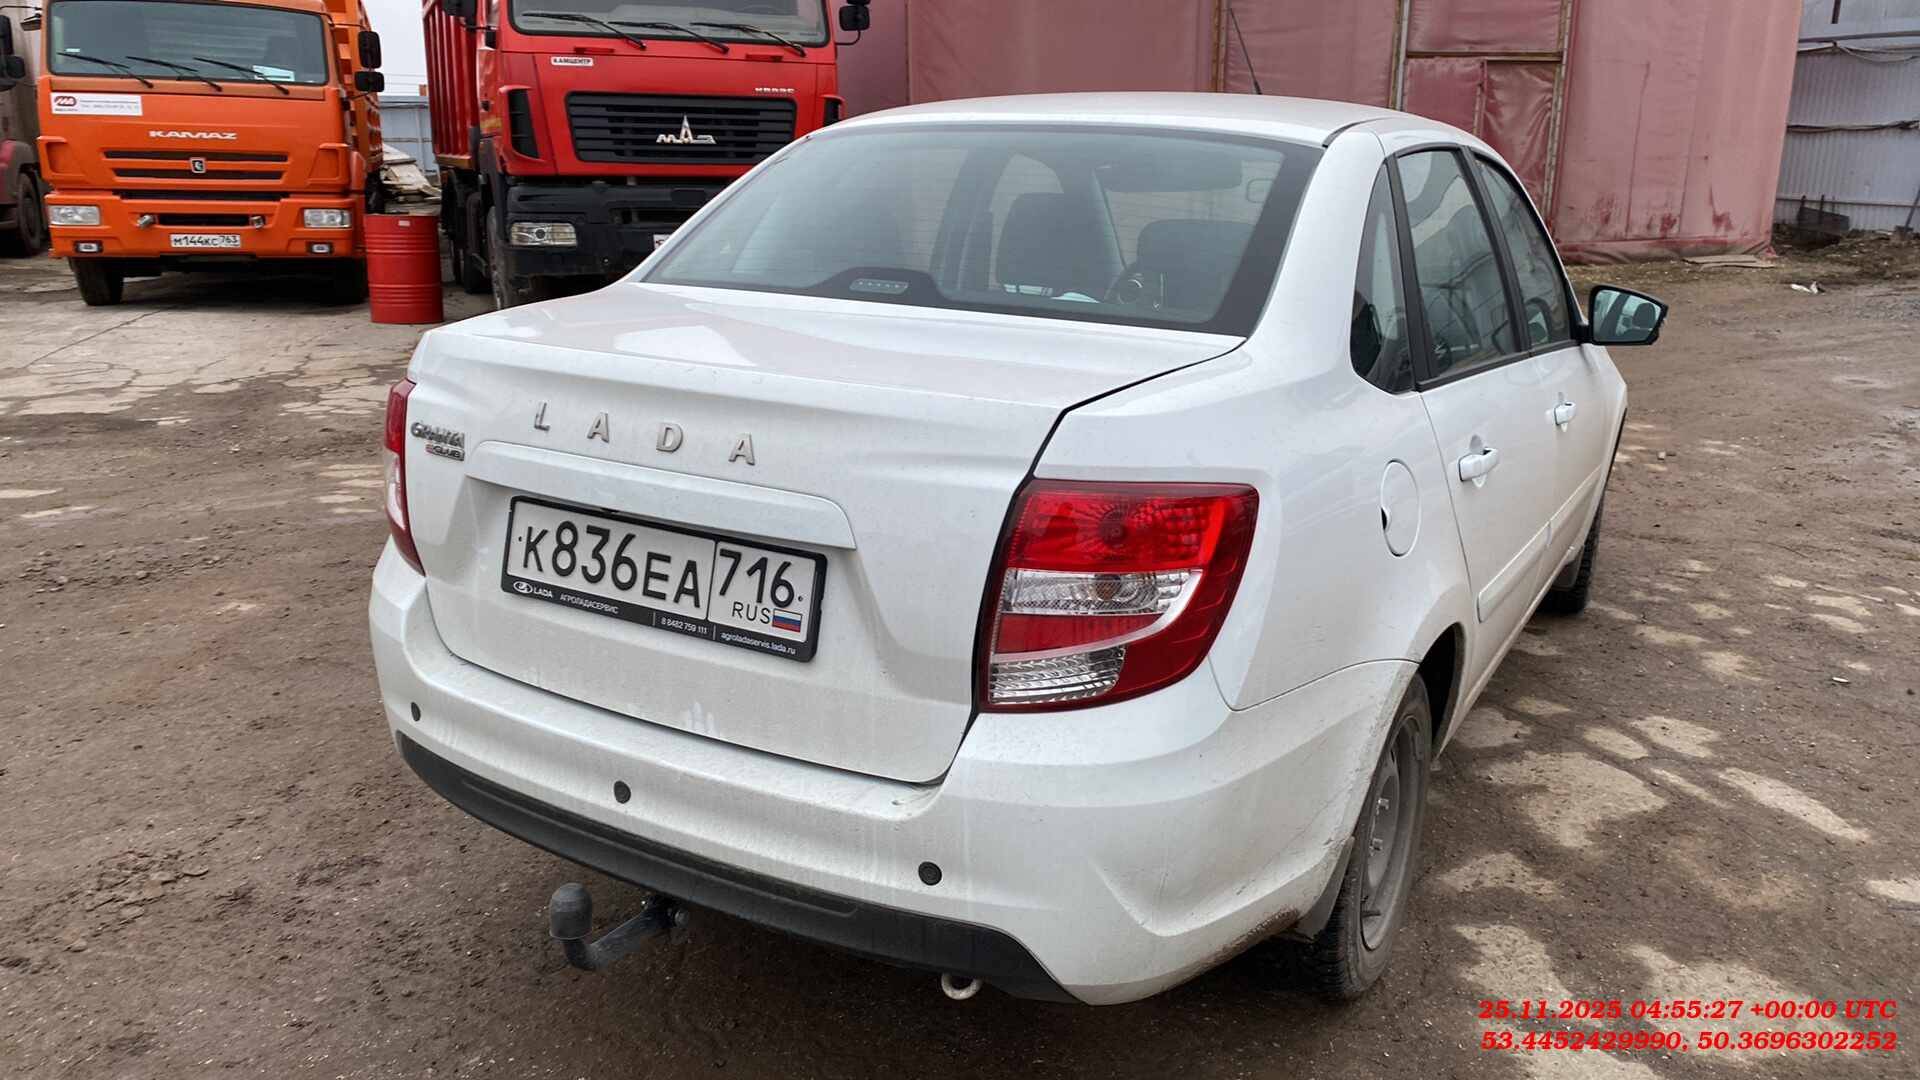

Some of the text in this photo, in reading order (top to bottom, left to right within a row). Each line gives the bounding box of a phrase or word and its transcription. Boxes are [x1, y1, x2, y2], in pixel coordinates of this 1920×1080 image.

[149, 131, 237, 139] KAMAZ
[534, 401, 755, 466] LADA
[523, 520, 796, 609] К836ЕА 716
[533, 586, 553, 598] LADA
[731, 601, 771, 625] RUS
